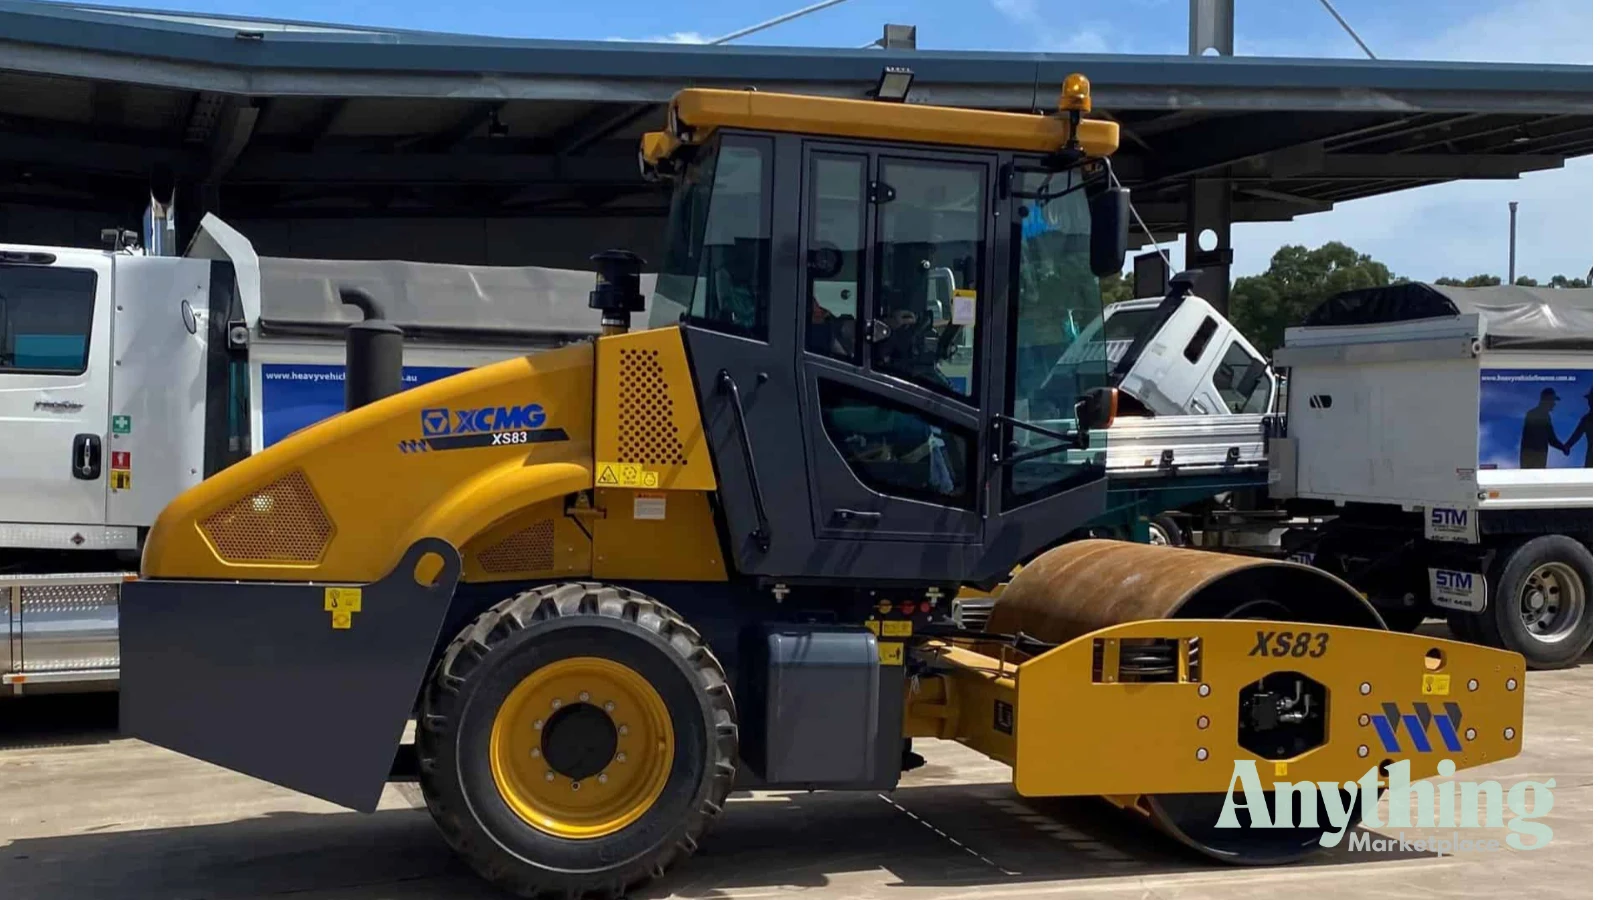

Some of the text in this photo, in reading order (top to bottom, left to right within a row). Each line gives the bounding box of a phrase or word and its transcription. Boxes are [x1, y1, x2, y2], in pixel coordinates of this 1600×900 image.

[450, 404, 547, 434] XCMG
[491, 431, 528, 446] XS83
[1431, 507, 1467, 526] STM
[1436, 570, 1472, 589] STM
[1248, 630, 1330, 659] XS83
